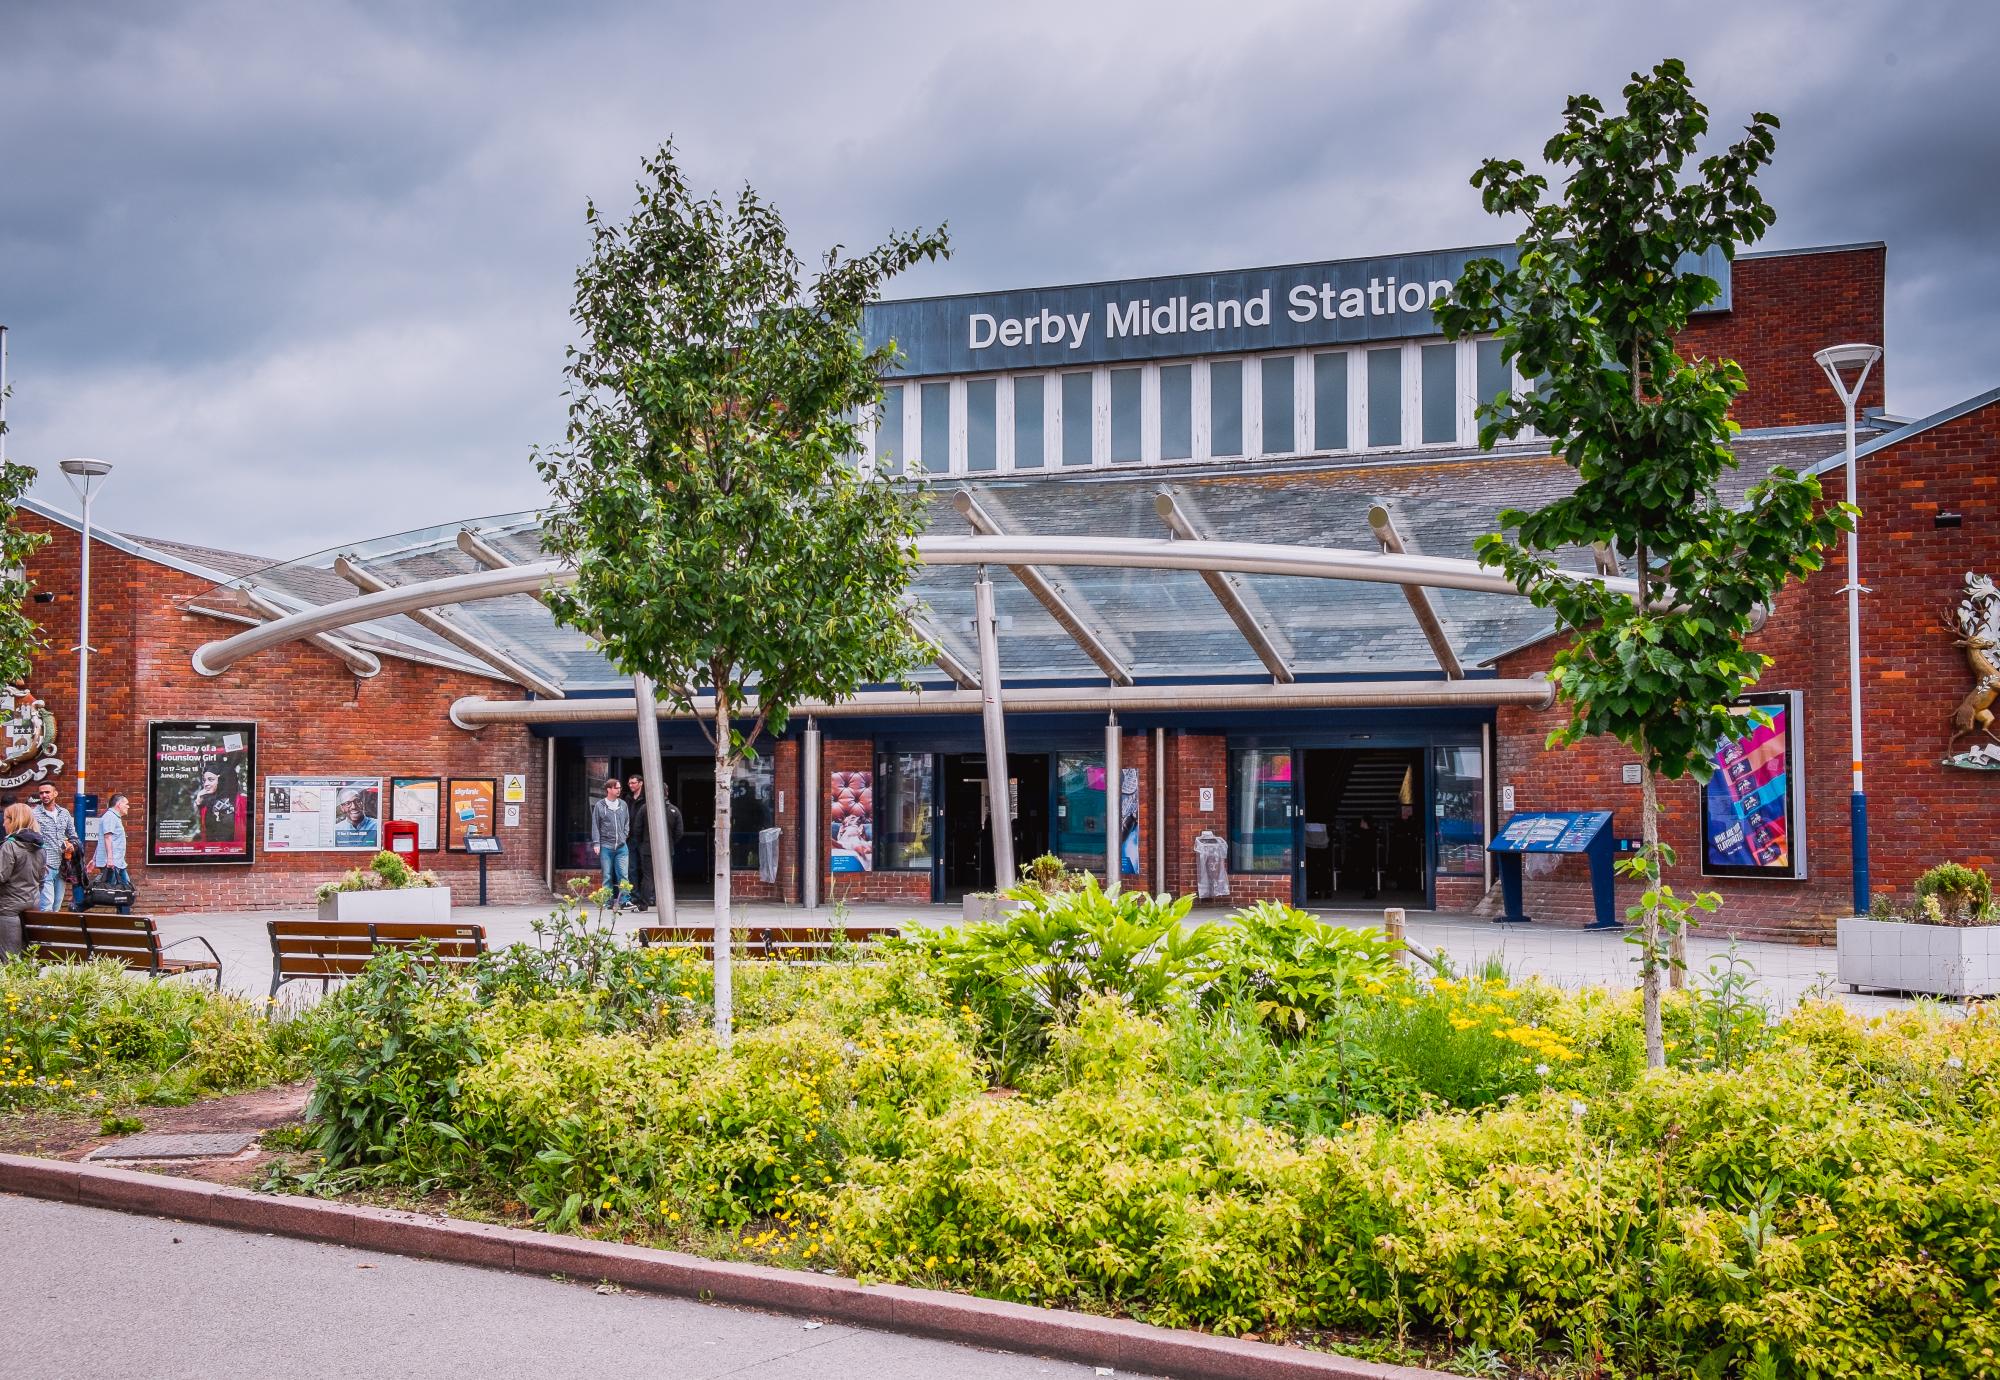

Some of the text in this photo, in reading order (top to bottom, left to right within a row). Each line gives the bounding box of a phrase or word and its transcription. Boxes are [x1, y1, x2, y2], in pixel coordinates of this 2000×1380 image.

[969, 277, 1453, 349] Derby Midland Station
[161, 744, 177, 752] The
[177, 744, 200, 754] Diary
[201, 744, 210, 752] of
